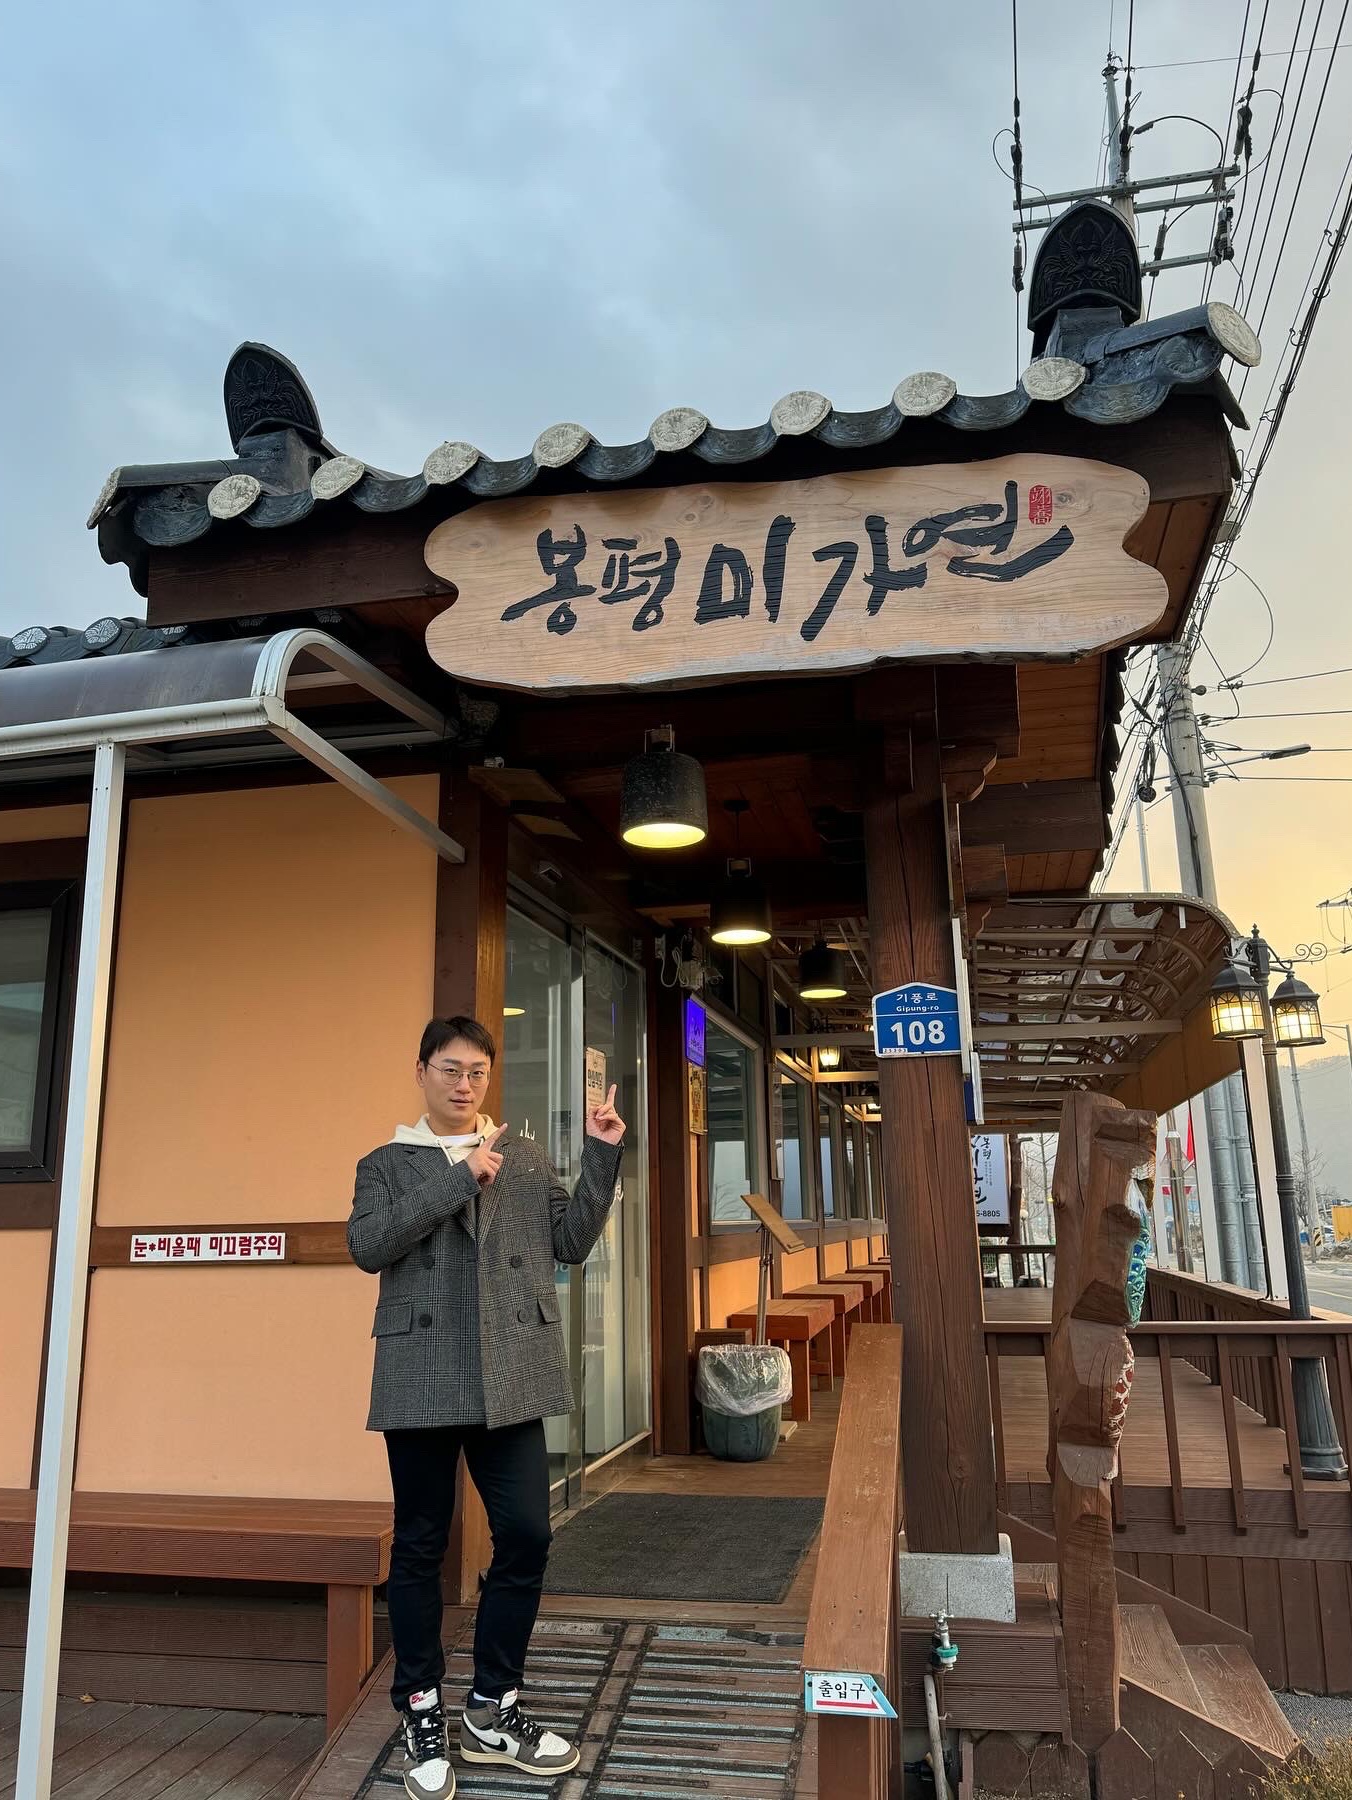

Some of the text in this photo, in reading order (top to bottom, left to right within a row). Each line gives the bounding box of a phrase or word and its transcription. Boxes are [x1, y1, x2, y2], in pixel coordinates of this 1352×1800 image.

[896, 992, 938, 1004] 기풍로
[896, 1005, 939, 1013] Gipung-ro
[890, 1020, 945, 1046] 108
[209, 1236, 282, 1257] 미끄럼주의
[818, 1680, 866, 1700] 출입구
